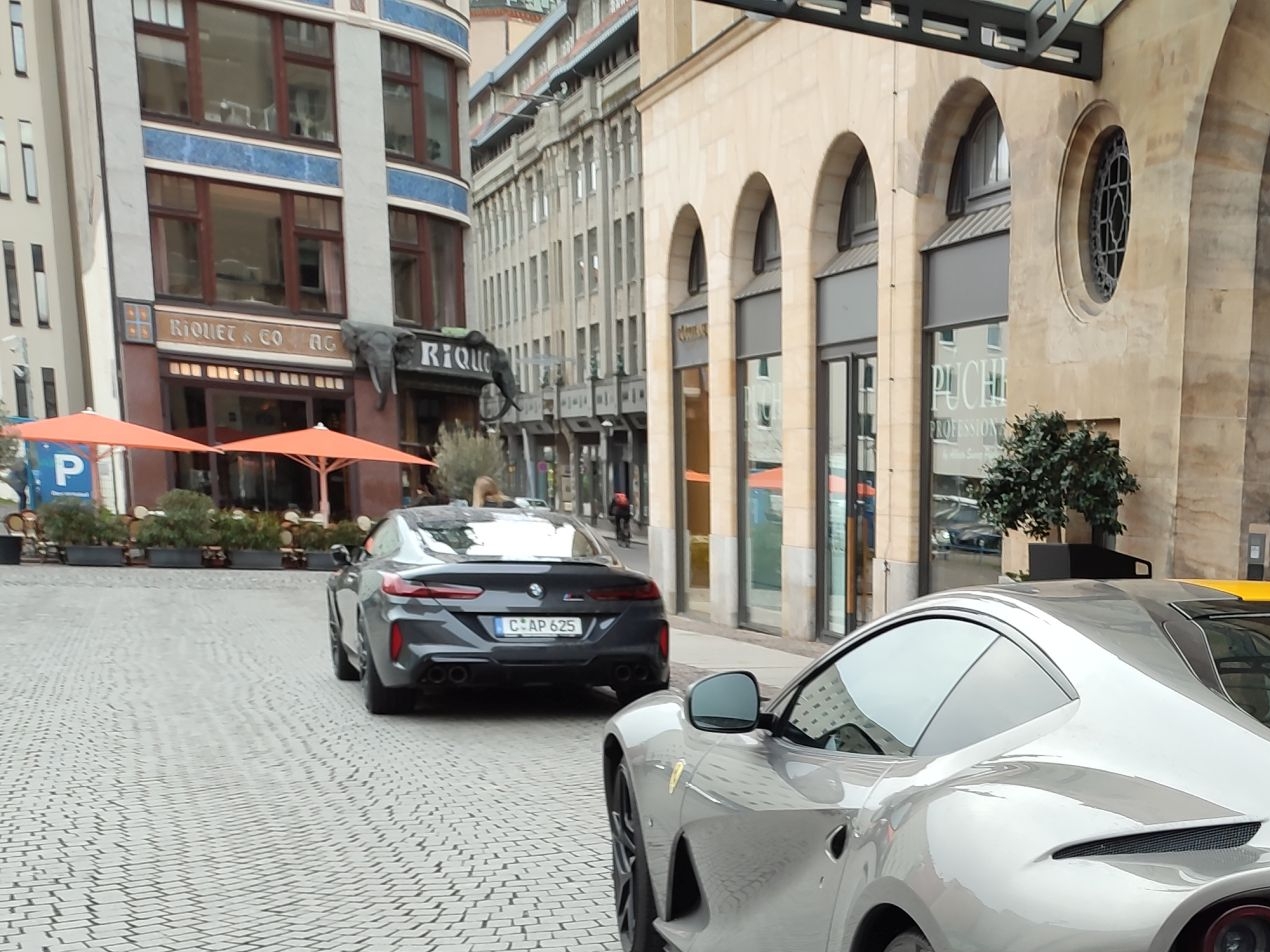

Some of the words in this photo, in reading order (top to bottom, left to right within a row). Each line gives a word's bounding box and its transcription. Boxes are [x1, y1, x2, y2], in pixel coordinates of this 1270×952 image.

[53, 453, 85, 487] P
[509, 619, 519, 632] C
[528, 618, 547, 632] AP
[550, 618, 576, 632] 625
